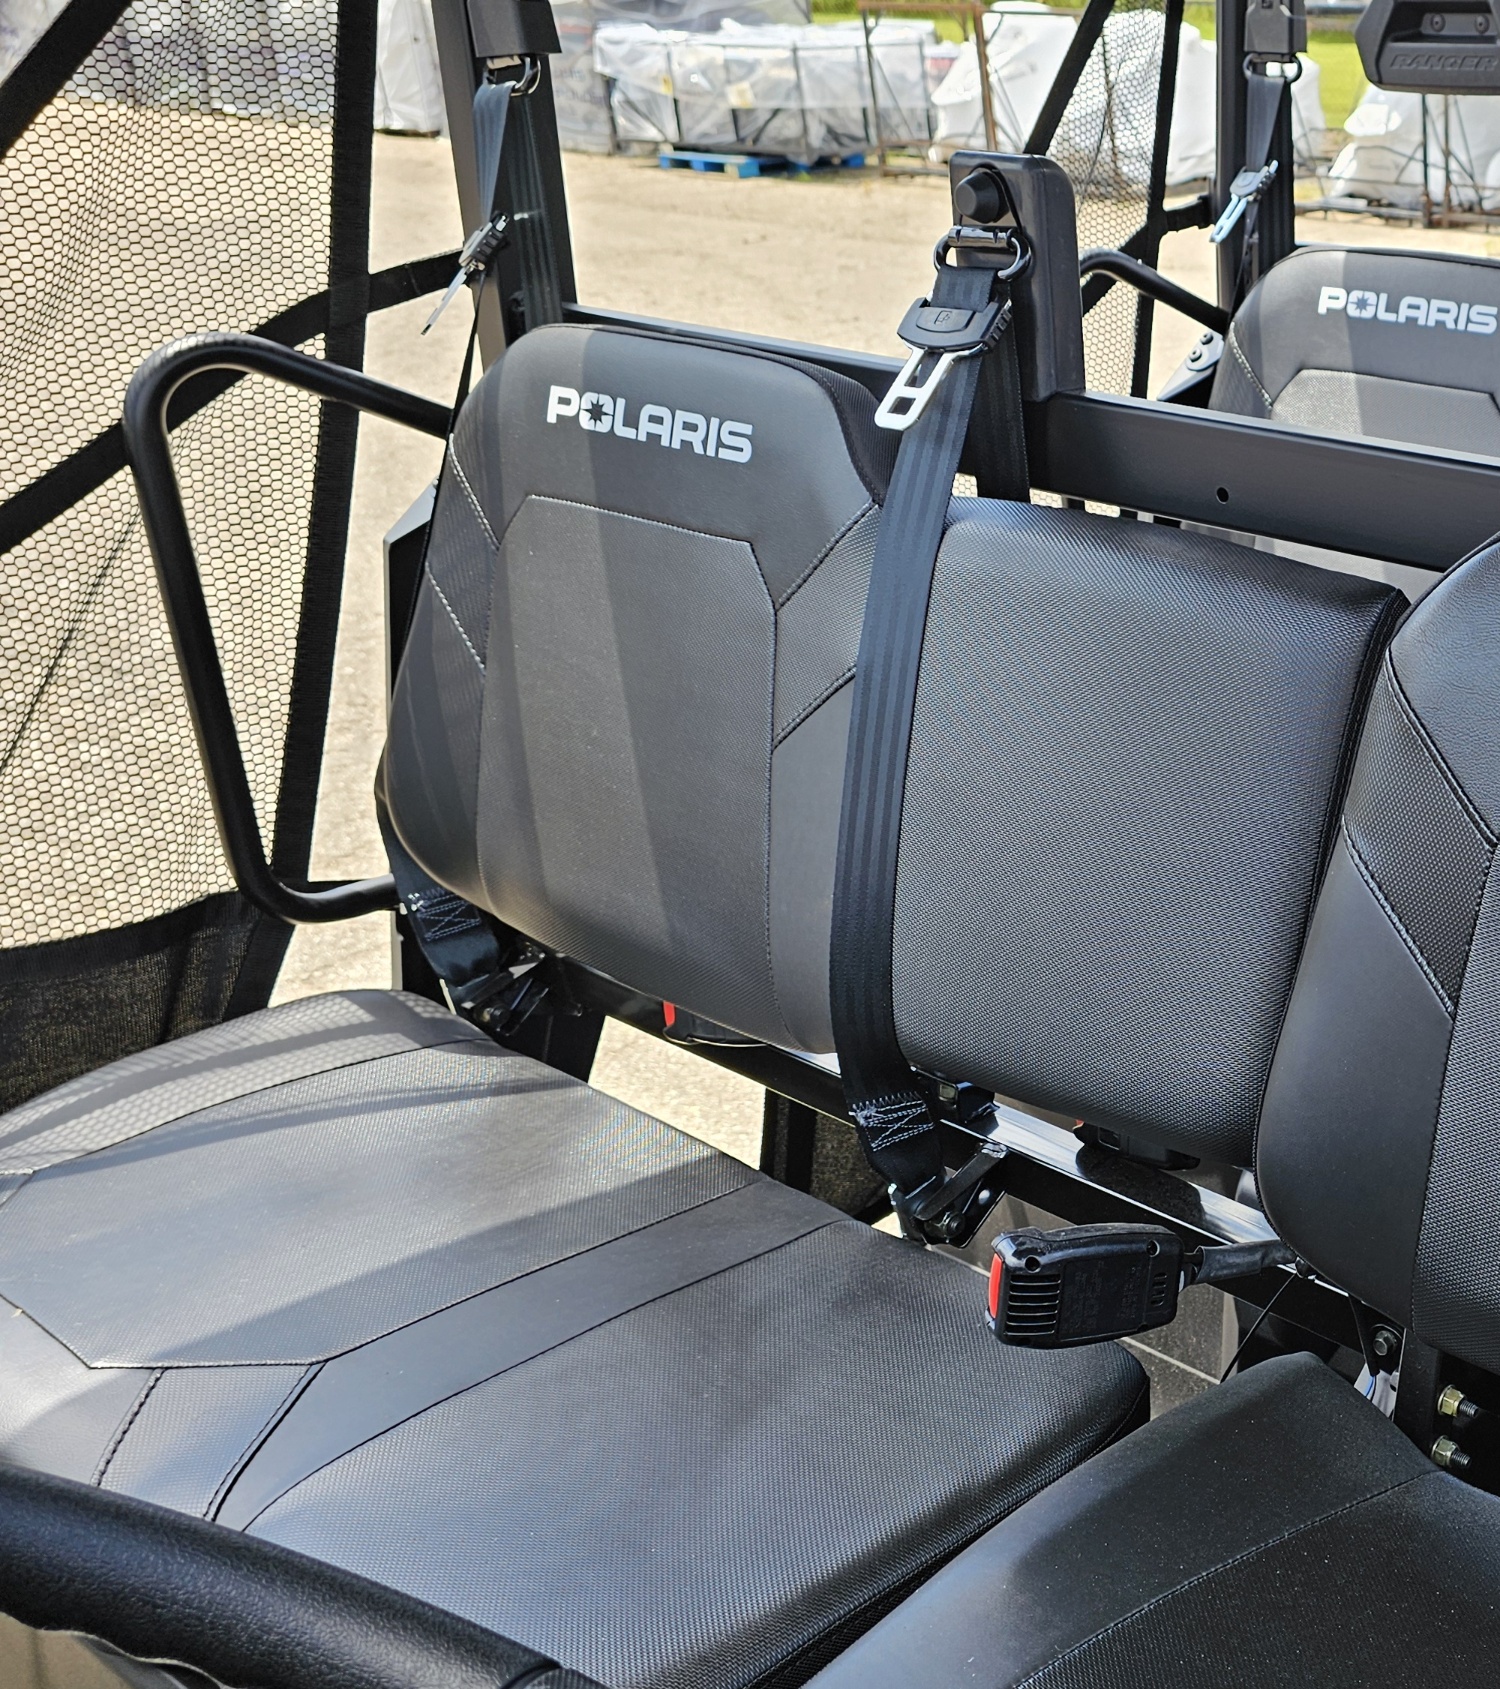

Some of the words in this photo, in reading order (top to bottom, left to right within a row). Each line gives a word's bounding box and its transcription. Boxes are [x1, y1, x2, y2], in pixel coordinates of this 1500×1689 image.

[1390, 54, 1498, 71] RANGER
[1317, 286, 1498, 334] POLARIS
[546, 385, 753, 463] POLARIS
